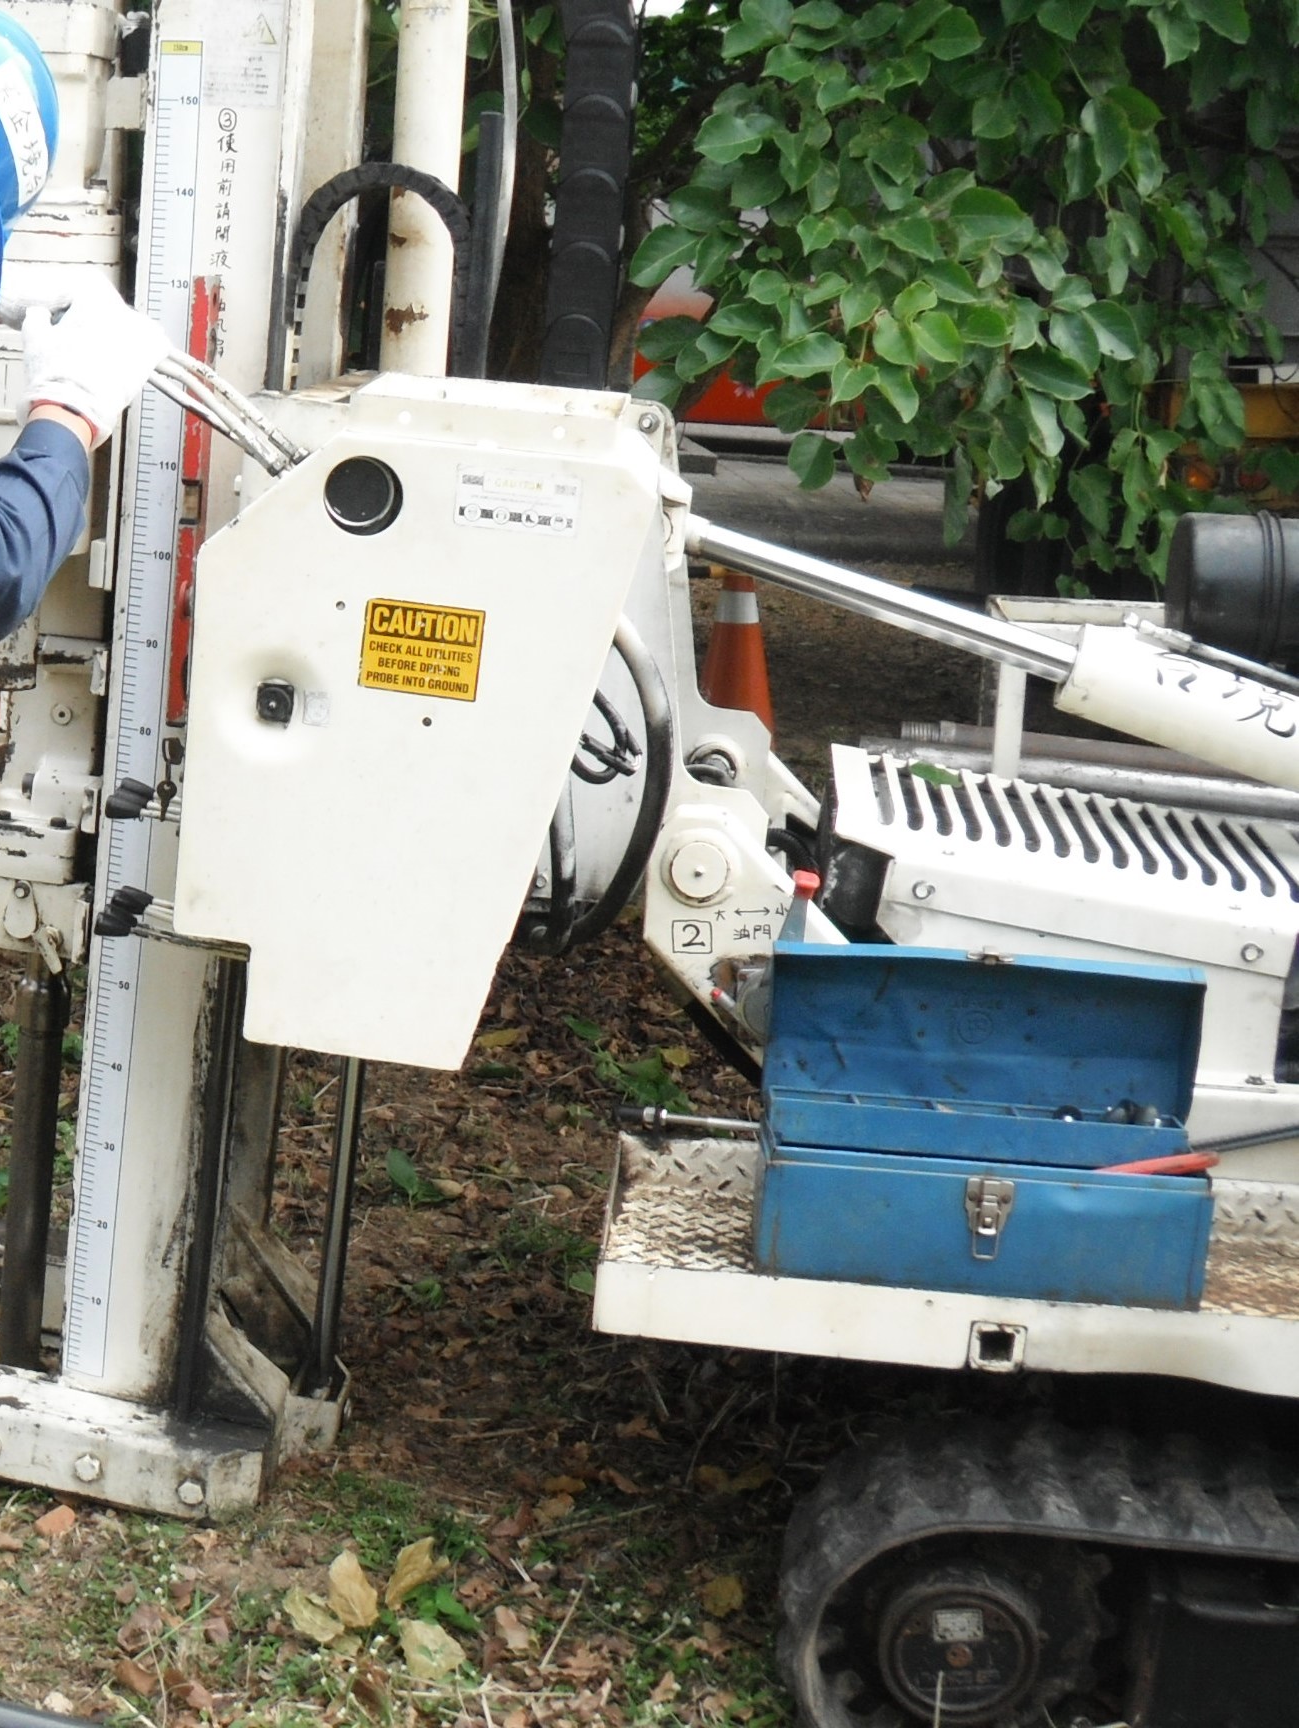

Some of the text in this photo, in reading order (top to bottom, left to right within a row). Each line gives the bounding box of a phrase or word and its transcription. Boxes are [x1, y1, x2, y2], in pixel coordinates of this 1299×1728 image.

[180, 96, 198, 105] 150
[176, 188, 194, 197] 140
[171, 279, 189, 289] 130
[159, 462, 176, 471] 110
[153, 551, 171, 561] 100
[372, 606, 477, 643] CAUTION
[146, 639, 158, 649] 90
[369, 641, 473, 664] CHECK ALL UTILITIES
[378, 657, 461, 678] BEFORE DRIVING
[366, 671, 469, 694] PROBE INTO GROUND
[139, 726, 151, 736] 80
[682, 924, 706, 948] 2
[733, 923, 771, 940] 油門
[118, 980, 130, 991] 50
[111, 1062, 122, 1072] 40
[103, 1141, 115, 1151] 30
[96, 1219, 108, 1230] 20
[91, 1296, 101, 1306] 10
